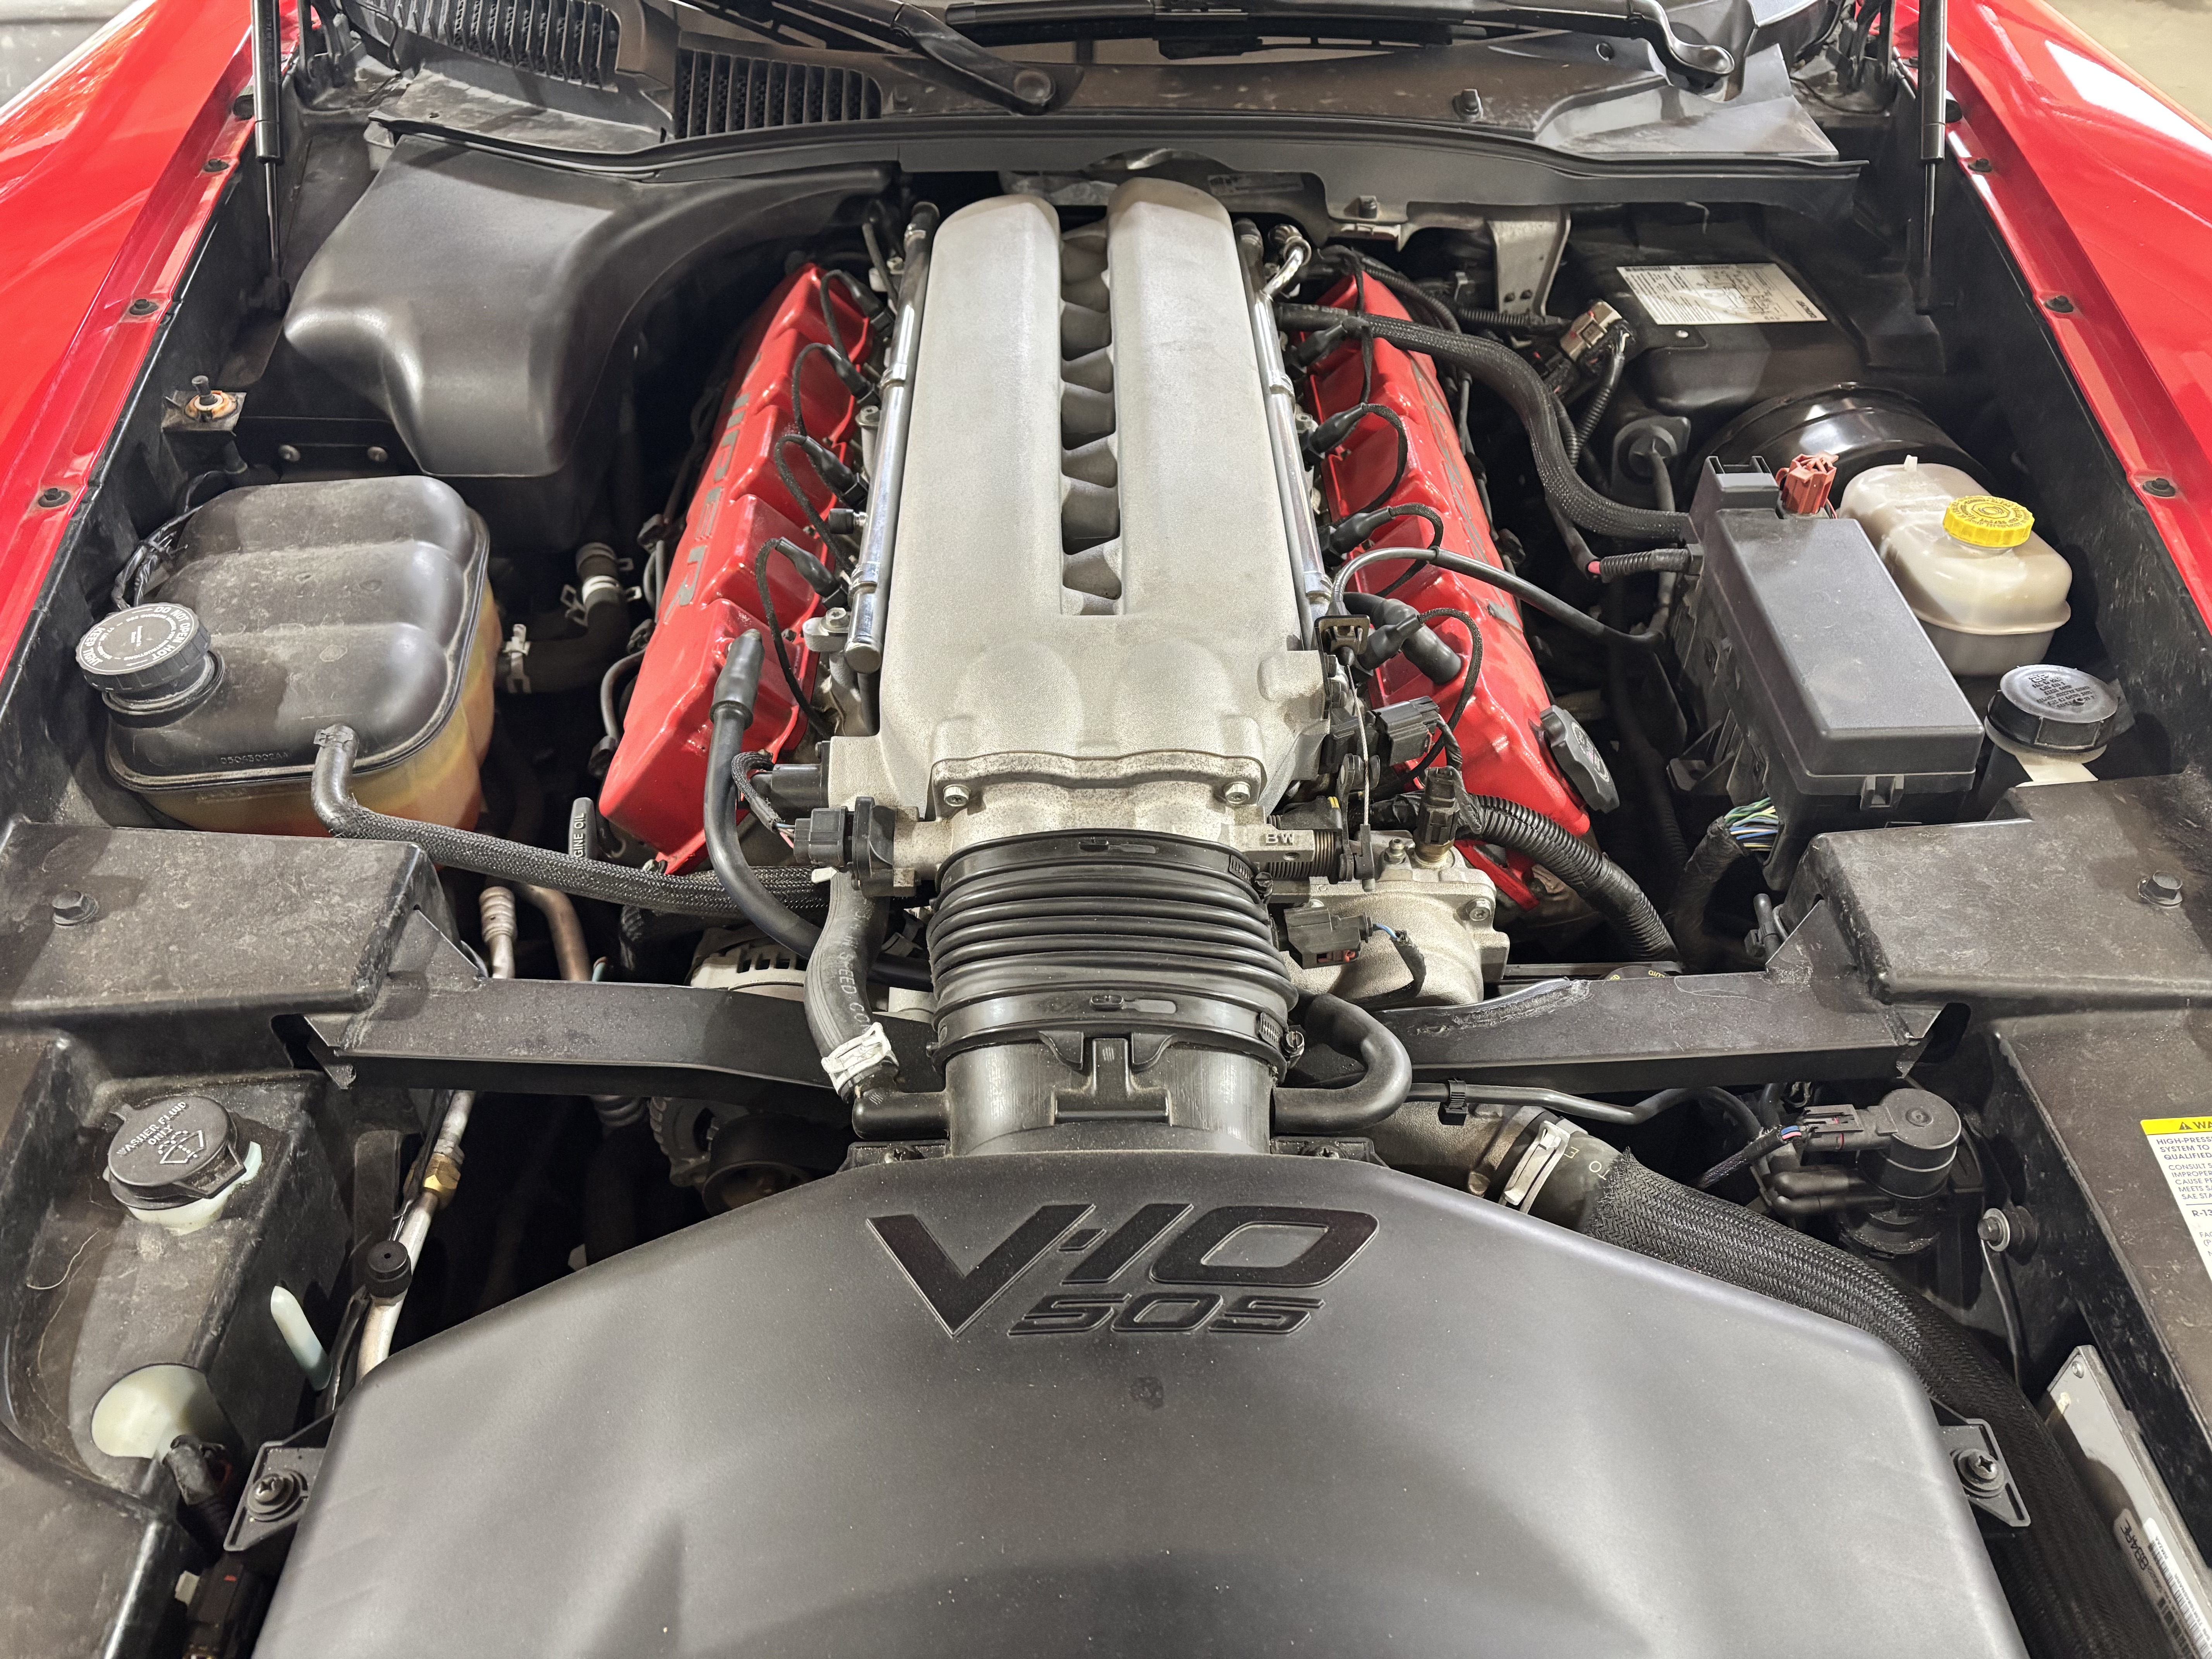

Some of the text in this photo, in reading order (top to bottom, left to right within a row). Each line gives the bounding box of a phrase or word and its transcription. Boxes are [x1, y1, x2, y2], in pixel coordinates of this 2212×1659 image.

[170, 609, 190, 622] NOT
[84, 627, 106, 647] KEEP
[175, 622, 191, 643] OPEN
[83, 647, 103, 666] TIGHT
[152, 644, 175, 660] HOT
[573, 812, 584, 858] GINE OIL
[1265, 831, 1295, 845] BW
[1648, 970, 1666, 979] LUID
[116, 1101, 186, 1155] WASHER FLUID
[148, 1125, 173, 1145] ONLY
[2156, 1136, 2212, 1145] HIGH-PRESS
[1589, 1161, 1610, 1180] TO
[1008, 1292, 1325, 1336] 505
